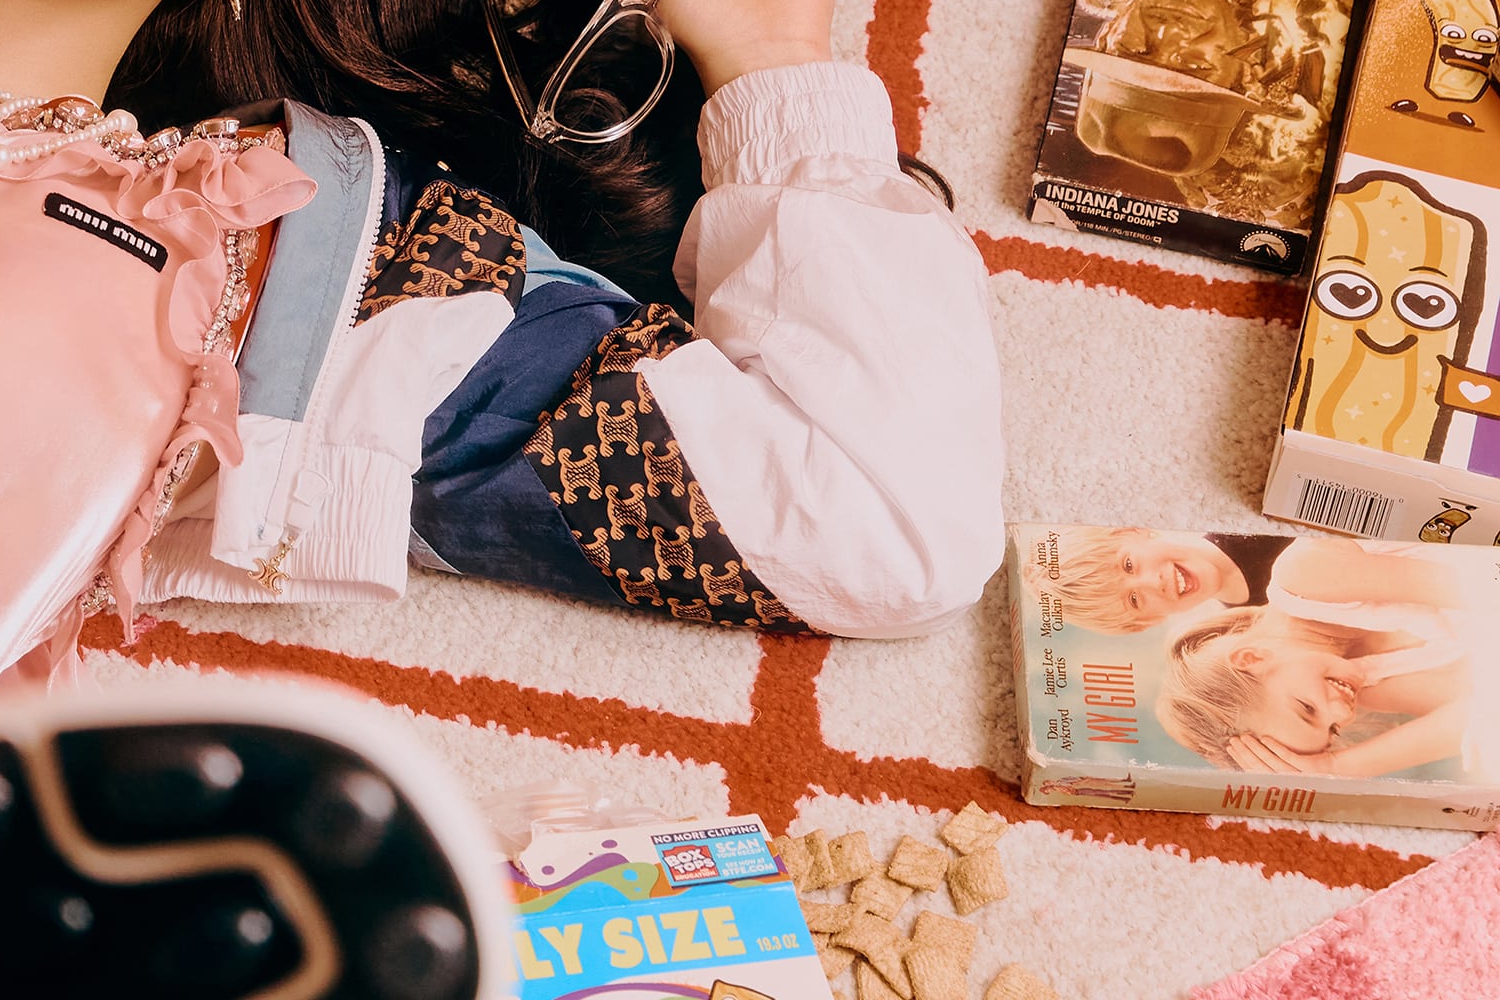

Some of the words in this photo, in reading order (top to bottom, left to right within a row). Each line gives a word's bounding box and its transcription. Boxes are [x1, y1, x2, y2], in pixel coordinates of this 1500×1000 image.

[1045, 184, 1119, 212] INDIANA
[1121, 200, 1180, 224] JONES
[1061, 201, 1076, 211] the
[1076, 205, 1112, 219] TEMPLE
[1113, 213, 1126, 221] OF
[1352, 487, 1384, 499] 16000
[1036, 542, 1047, 569] Anna
[1048, 531, 1060, 581] Chlumsky
[1040, 591, 1052, 638] Macaulay
[1051, 598, 1063, 632] Culkin
[1042, 648, 1054, 665] Lee
[1044, 666, 1058, 698] Jamie
[1056, 656, 1067, 689] Curtis
[1082, 662, 1136, 708] GIRL
[1047, 718, 1058, 742] Dan
[1058, 708, 1072, 752] Aykroyd
[1086, 712, 1139, 744] MY
[1221, 784, 1260, 810] MY
[1262, 786, 1316, 814] GIRL
[653, 834, 672, 844] NO
[674, 831, 706, 842] MORE
[708, 824, 758, 839] CLIPPING
[715, 838, 760, 852] SCAN
[664, 848, 705, 867] BOX
[674, 858, 715, 874] TOPS
[716, 851, 736, 859] YOUR
[737, 848, 766, 858] RECEIPT
[675, 870, 718, 881] EDUCATION
[721, 863, 774, 876] BTFE.COM
[602, 906, 746, 969] SIZE
[756, 936, 782, 953] 19.3
[784, 933, 800, 950] OZ
